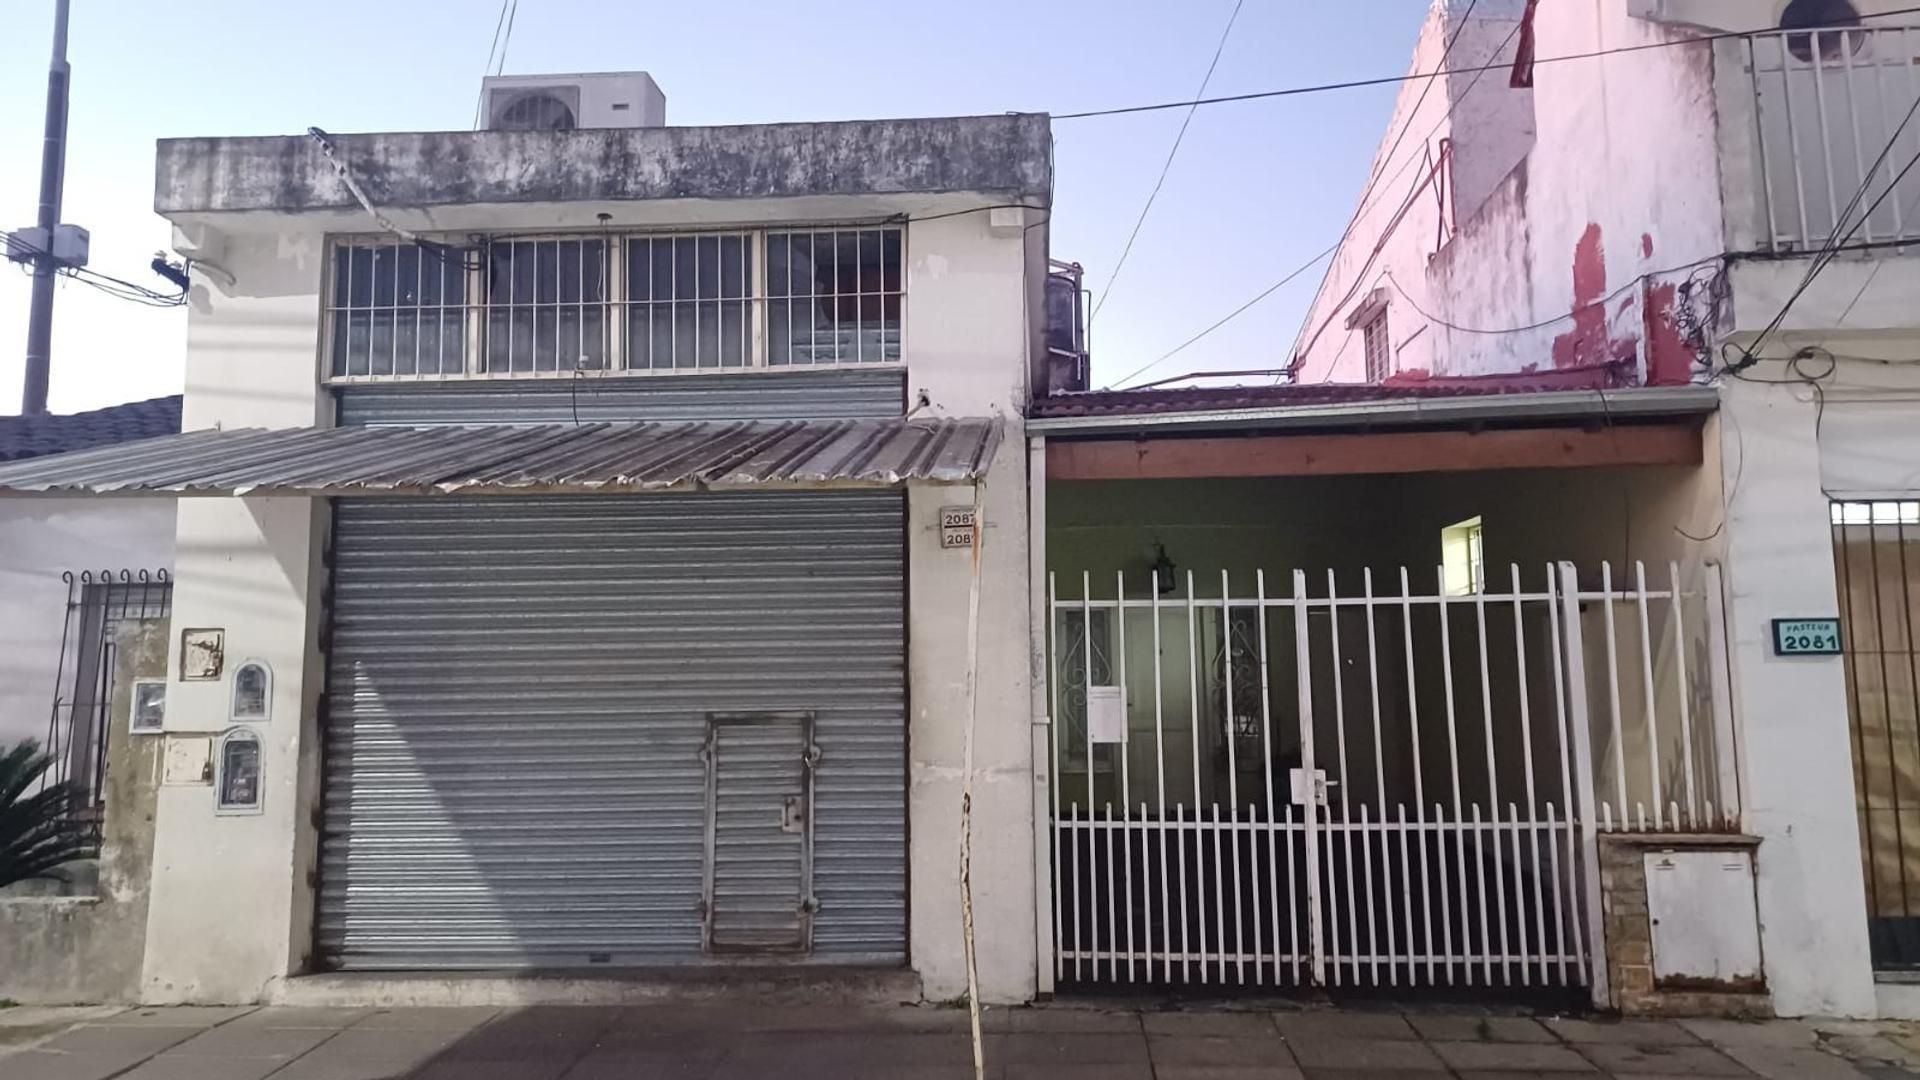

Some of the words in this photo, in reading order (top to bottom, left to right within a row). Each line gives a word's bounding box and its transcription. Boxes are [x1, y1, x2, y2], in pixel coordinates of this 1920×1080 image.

[947, 534, 974, 545] 208
[1786, 623, 1830, 632] PASTEUR
[1785, 635, 1836, 649] 2081
